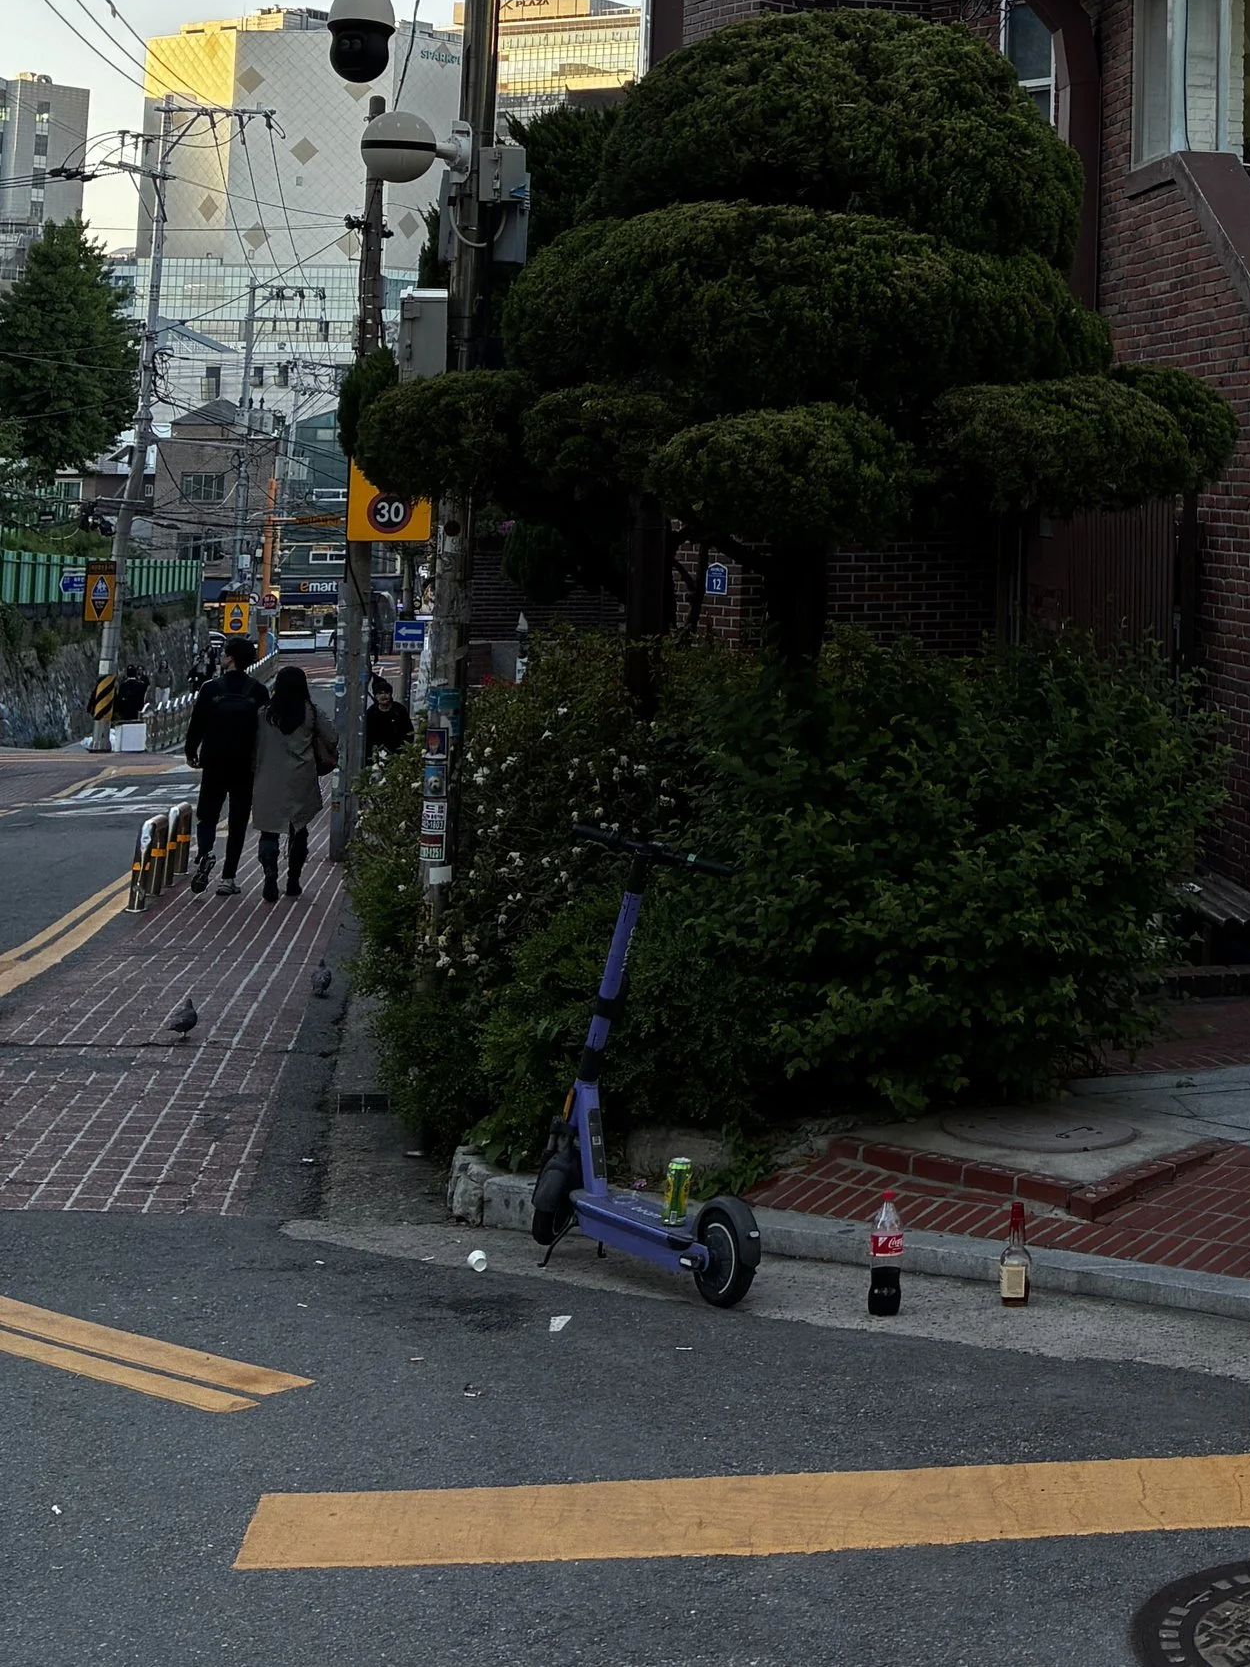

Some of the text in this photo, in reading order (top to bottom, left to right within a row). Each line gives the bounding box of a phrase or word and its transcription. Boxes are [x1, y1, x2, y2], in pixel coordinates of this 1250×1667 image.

[375, 501, 405, 523] 30
[299, 580, 338, 593] emart
[712, 578, 721, 590] 12
